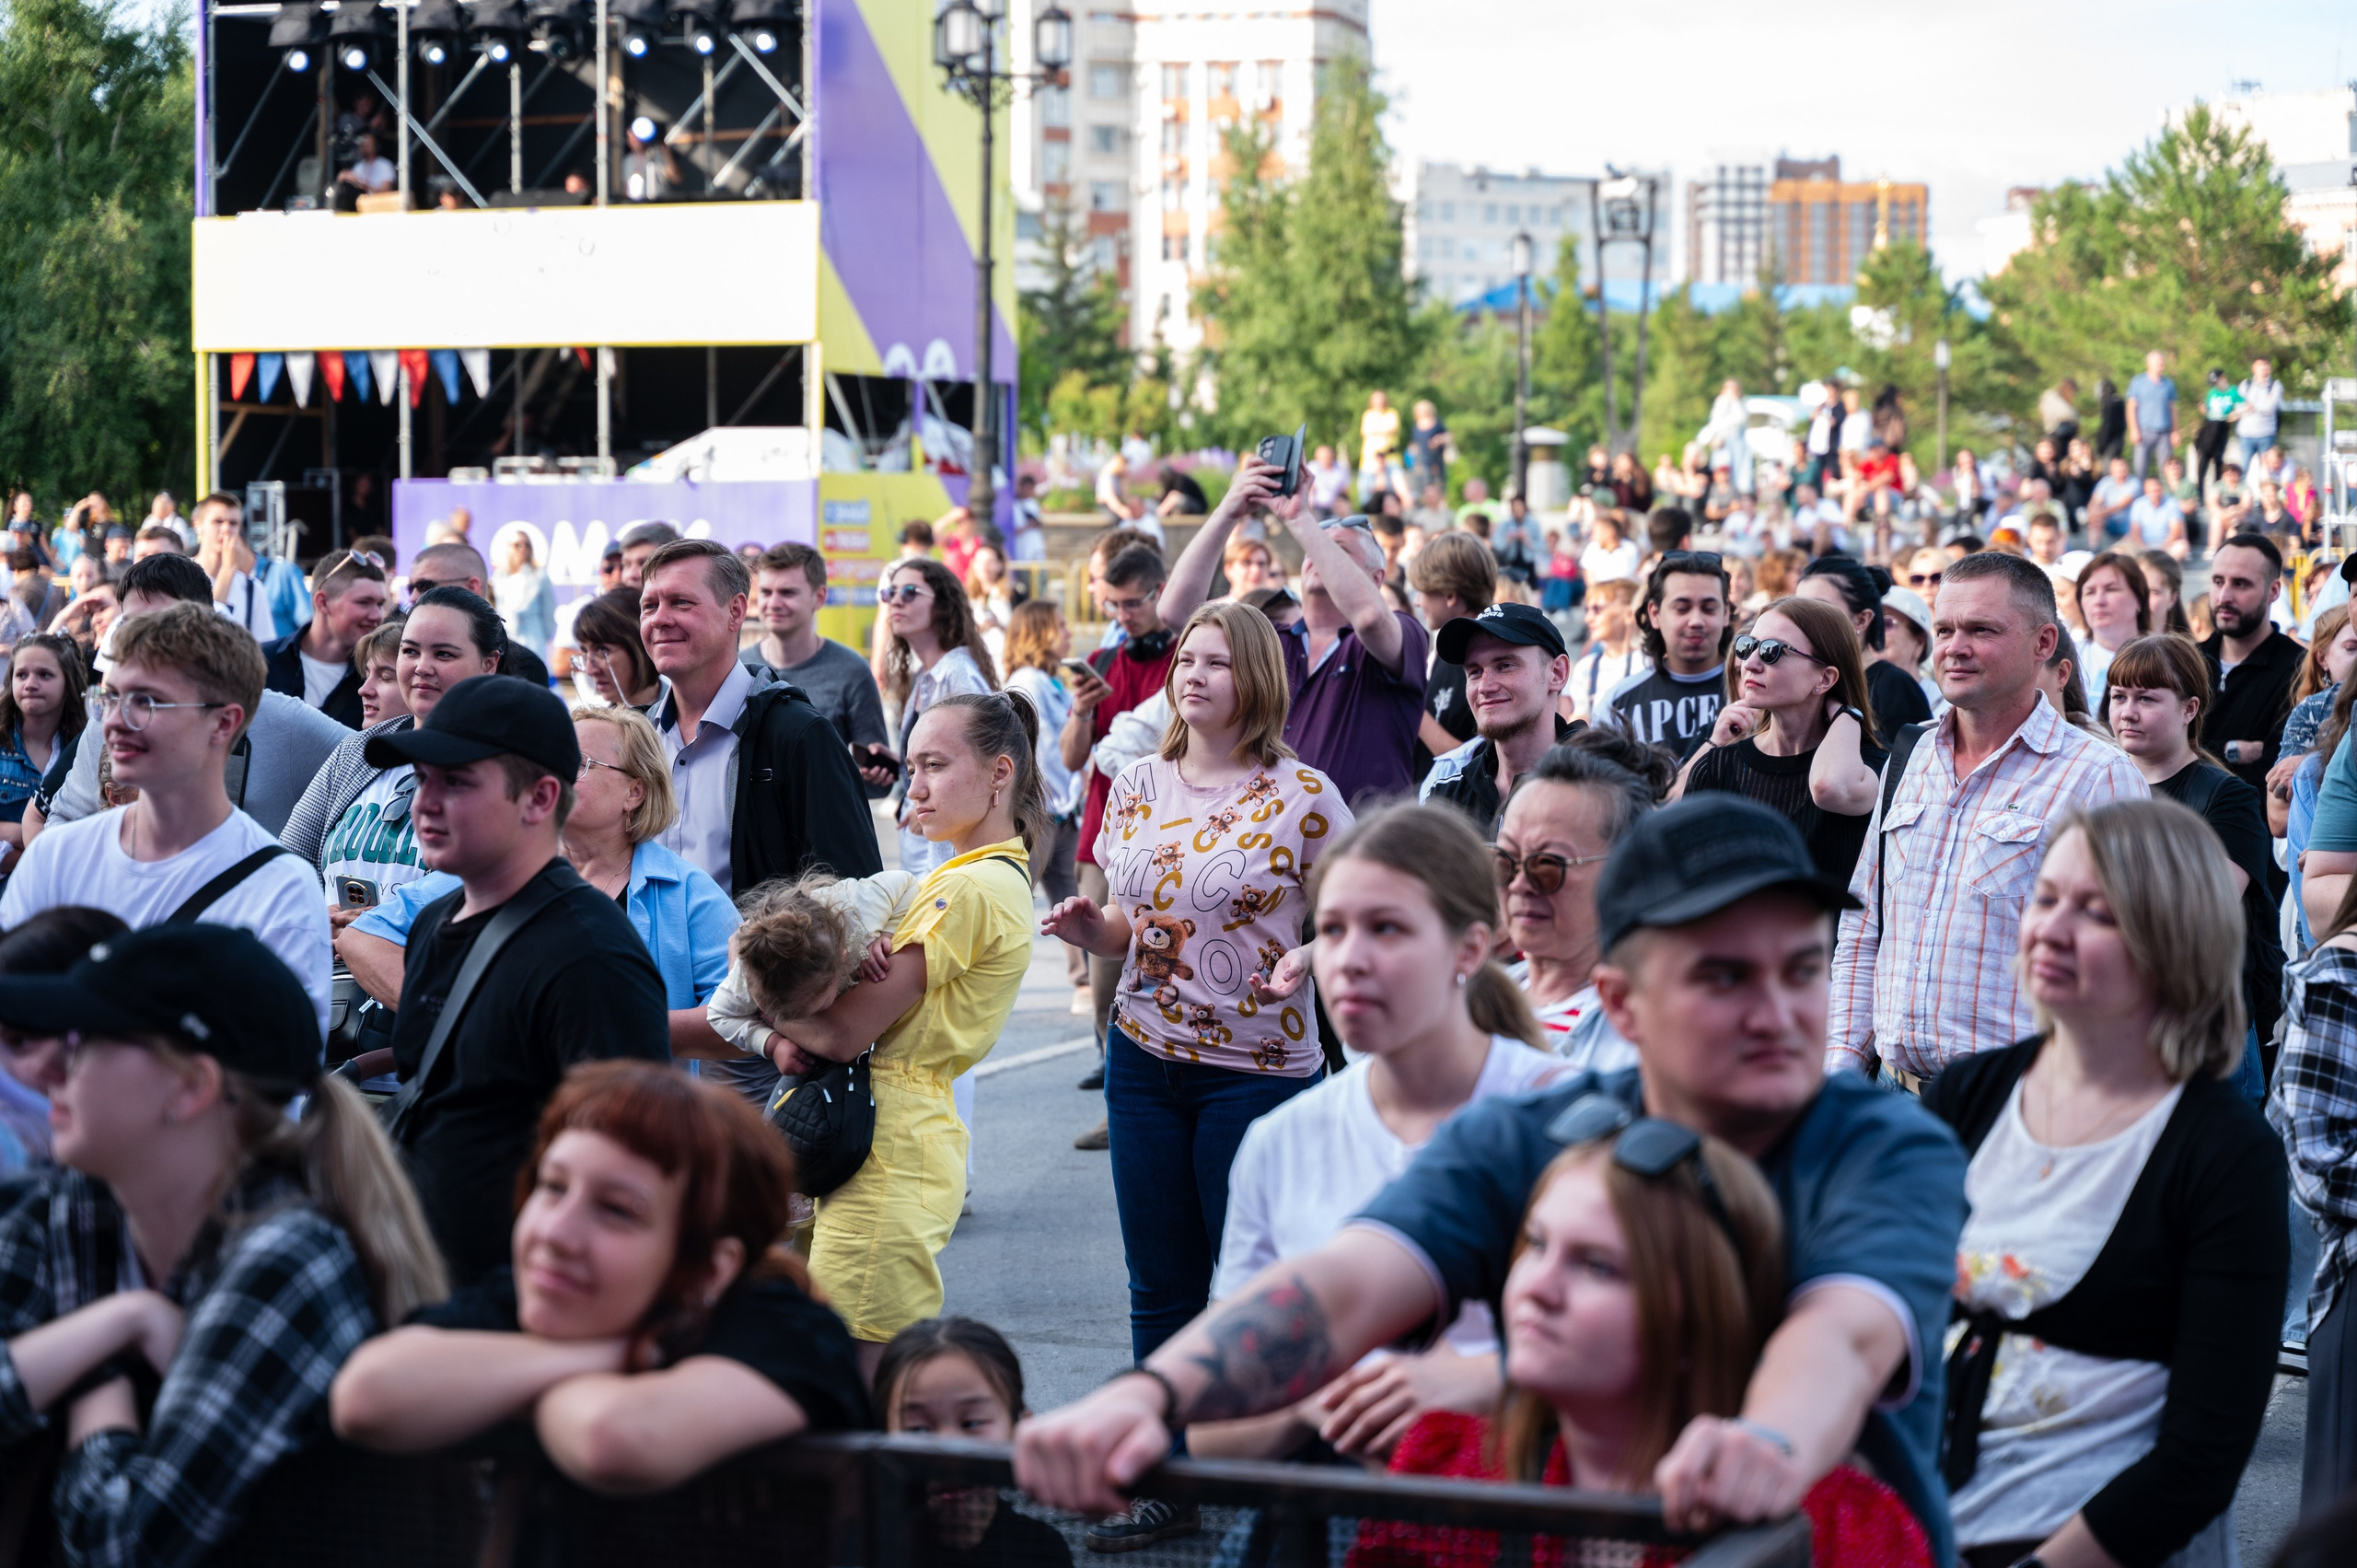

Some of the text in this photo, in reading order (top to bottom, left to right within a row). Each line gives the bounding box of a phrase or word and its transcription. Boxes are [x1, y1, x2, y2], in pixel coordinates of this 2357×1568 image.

[1618, 694, 1720, 744] АРСЕ
[1191, 849, 1246, 912] C
[1200, 938, 1243, 996] O
